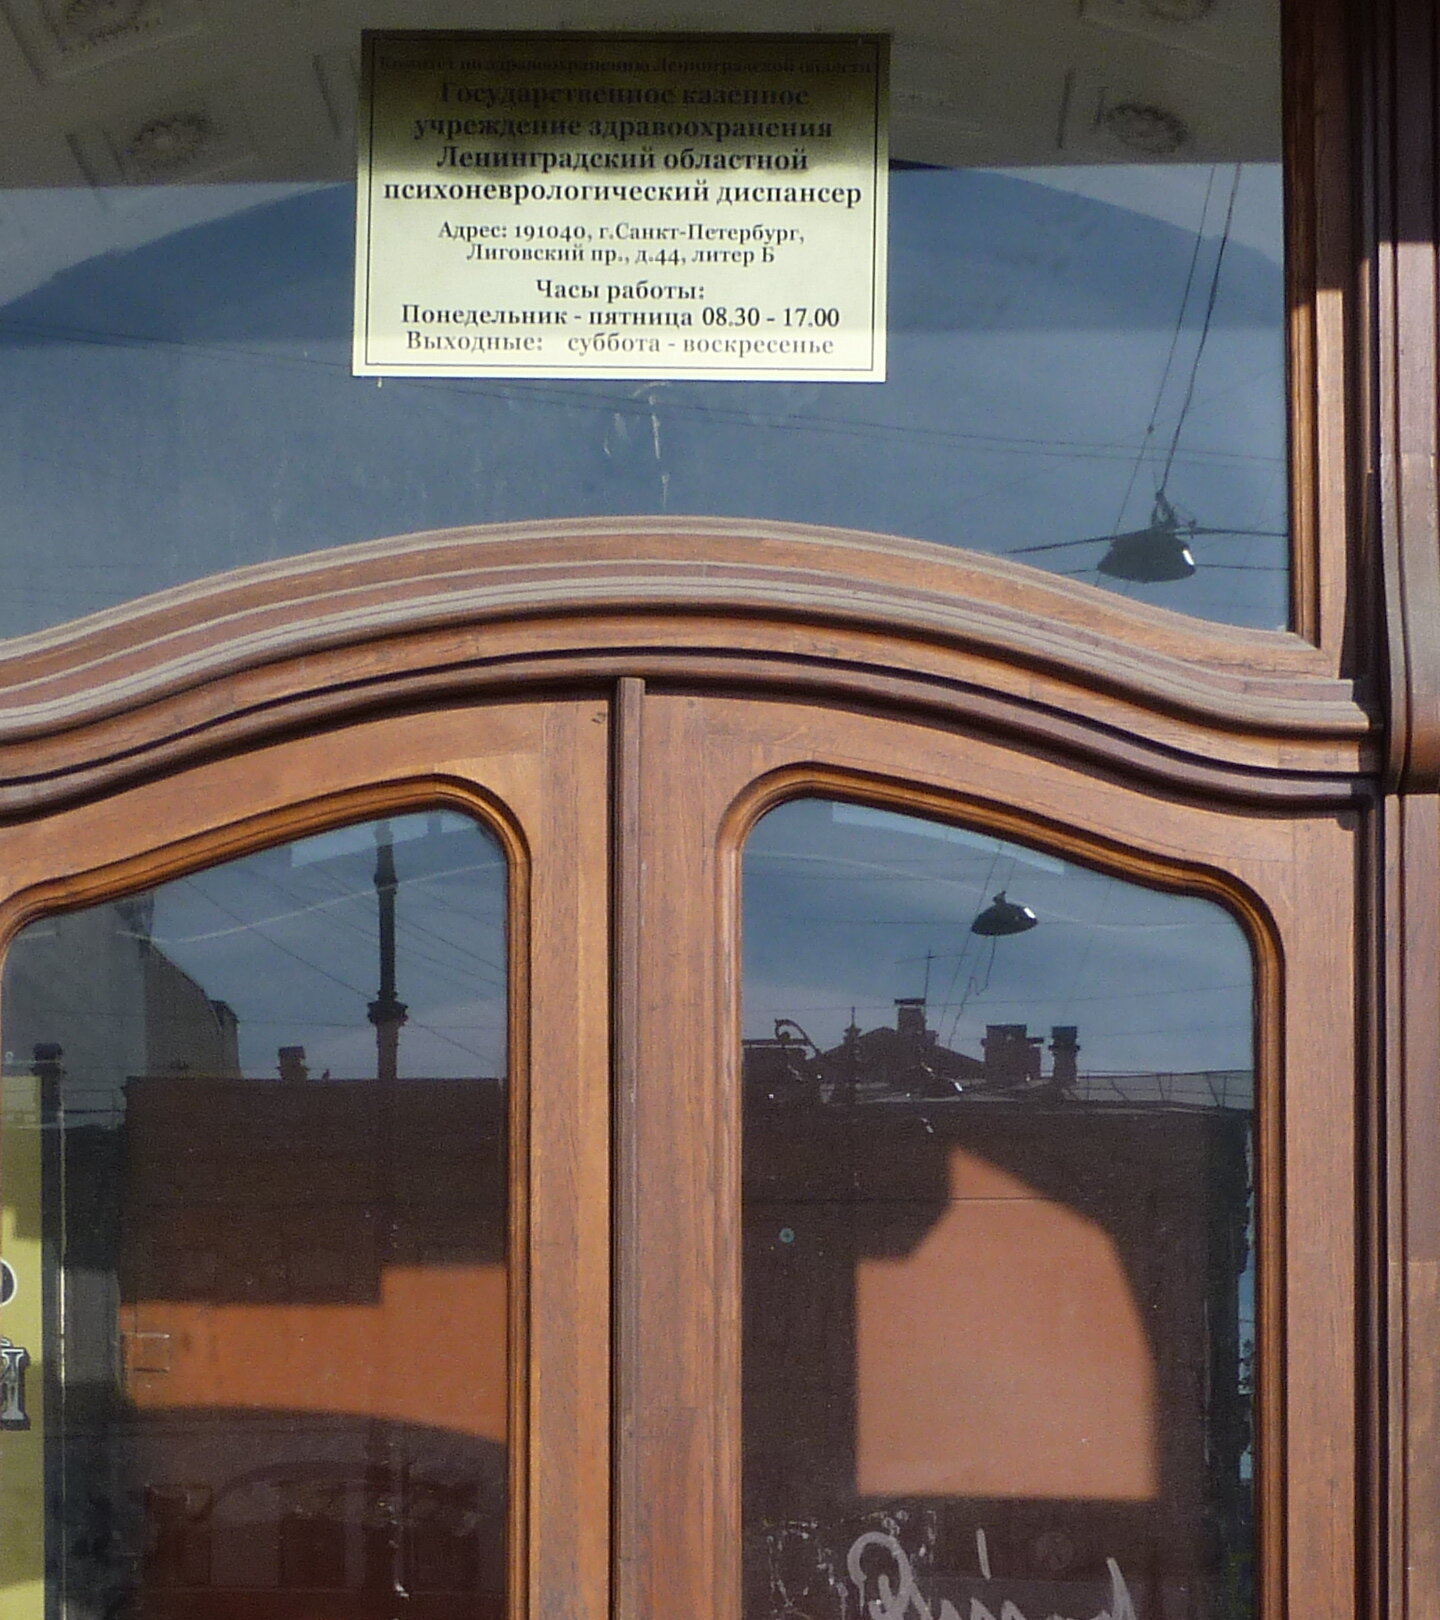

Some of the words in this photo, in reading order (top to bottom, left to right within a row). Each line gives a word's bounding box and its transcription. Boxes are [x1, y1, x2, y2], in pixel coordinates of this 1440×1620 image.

[441, 82, 675, 108] Государственное
[682, 87, 810, 105] казенное
[413, 116, 582, 140] учреждение
[588, 118, 833, 142] здравоохранения
[436, 145, 656, 173] Ленинградский
[663, 147, 810, 171] областной
[383, 179, 709, 206] психоневрологический
[716, 186, 862, 209] диспансер
[438, 221, 508, 243] Адрес:
[515, 223, 593, 242] 191040,
[466, 243, 585, 262] Лиговский
[591, 249, 630, 266] пр.,
[634, 248, 687, 266] д.44,
[692, 249, 755, 267] литер
[761, 246, 776, 264] Б
[535, 279, 600, 299] Часы
[606, 279, 705, 304] работы:
[401, 304, 569, 327] Понедельник
[589, 310, 693, 329] пятница
[701, 306, 760, 327] 08.30
[782, 307, 840, 328] 17.00
[407, 330, 543, 353] Выходные:
[567, 332, 661, 357] суббота
[682, 336, 835, 358] воскресенье
